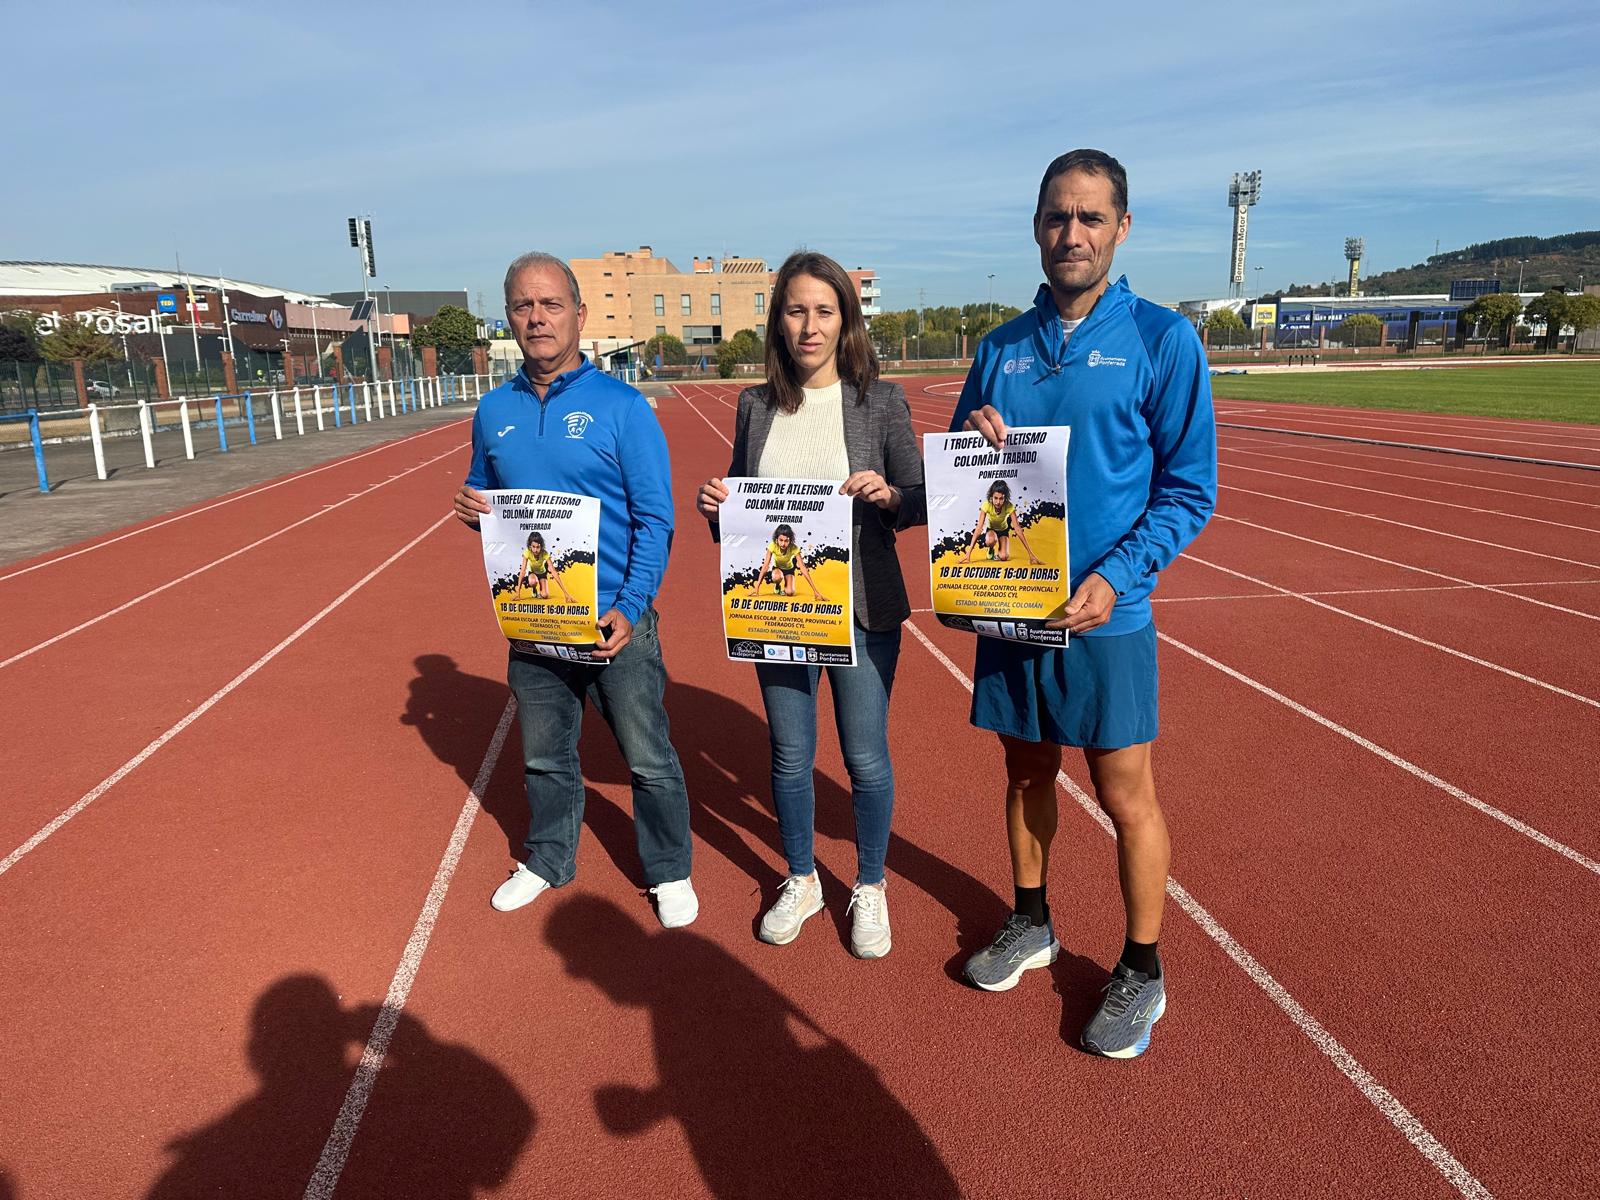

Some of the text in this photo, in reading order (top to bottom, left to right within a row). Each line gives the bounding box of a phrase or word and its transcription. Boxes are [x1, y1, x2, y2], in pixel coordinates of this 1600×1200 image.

[1236, 242, 1244, 281] Bernesga
[231, 308, 268, 322] Carrefour
[944, 439, 948, 450] I
[951, 437, 984, 450] TROFEO
[1004, 432, 1047, 446] TLETISMO
[954, 451, 1037, 467] COLOMÁN TRABADO
[978, 469, 1018, 479] PONFERRADA
[738, 483, 833, 495] I TROFEO DE ATLETISMO
[493, 495, 581, 506] I TROFEO DE ATLETISMO
[745, 497, 824, 511] COLOMÁN TRABADO
[503, 507, 572, 519] COLOMÁN TRABADO
[765, 514, 803, 523] PONFERRADA
[940, 567, 1059, 580] 18 DE OCTUBRE 16:00 HORAS
[500, 603, 590, 615] 18 DE OCTUBRE 16:00 HORAS
[731, 598, 842, 615] 18 DE OCTUBRE 16:00 HORAS
